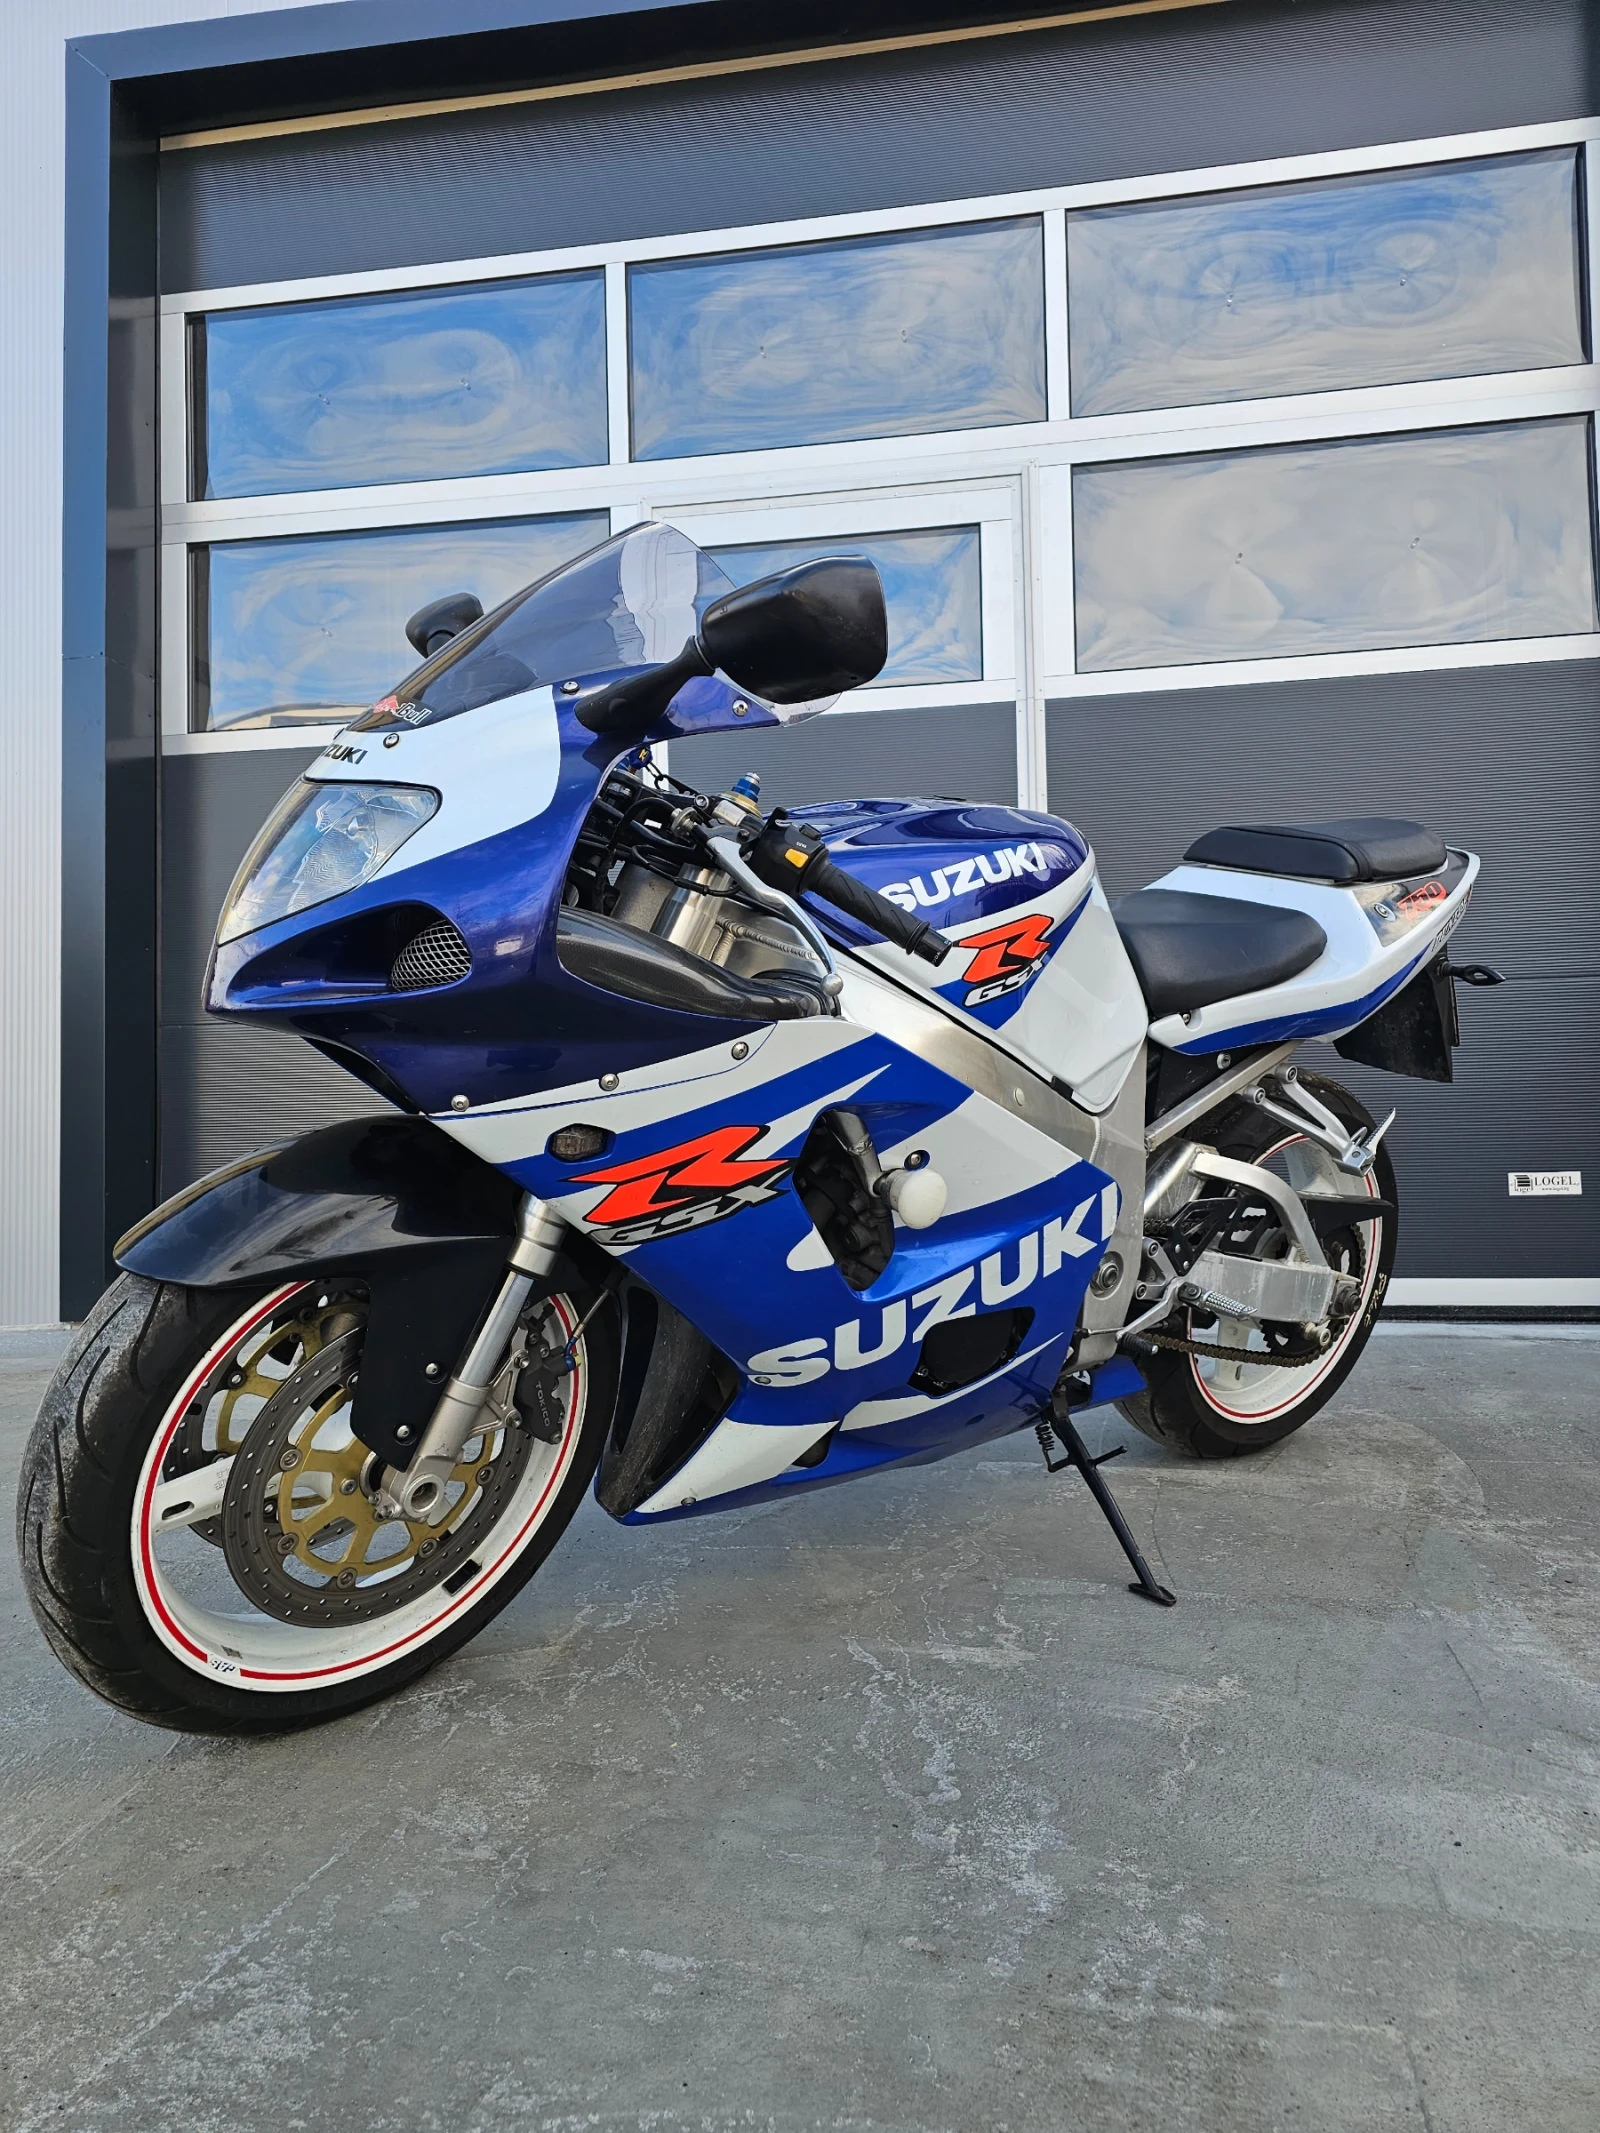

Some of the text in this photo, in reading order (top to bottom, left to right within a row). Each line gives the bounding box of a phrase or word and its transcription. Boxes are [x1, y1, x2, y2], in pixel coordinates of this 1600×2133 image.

[323, 744, 369, 765] ZUKI
[877, 842, 1048, 913] SUZUKI
[1397, 881, 1447, 920] 750
[747, 1181, 1119, 1388] SUZUKI
[534, 1380, 551, 1428] TOKICO
